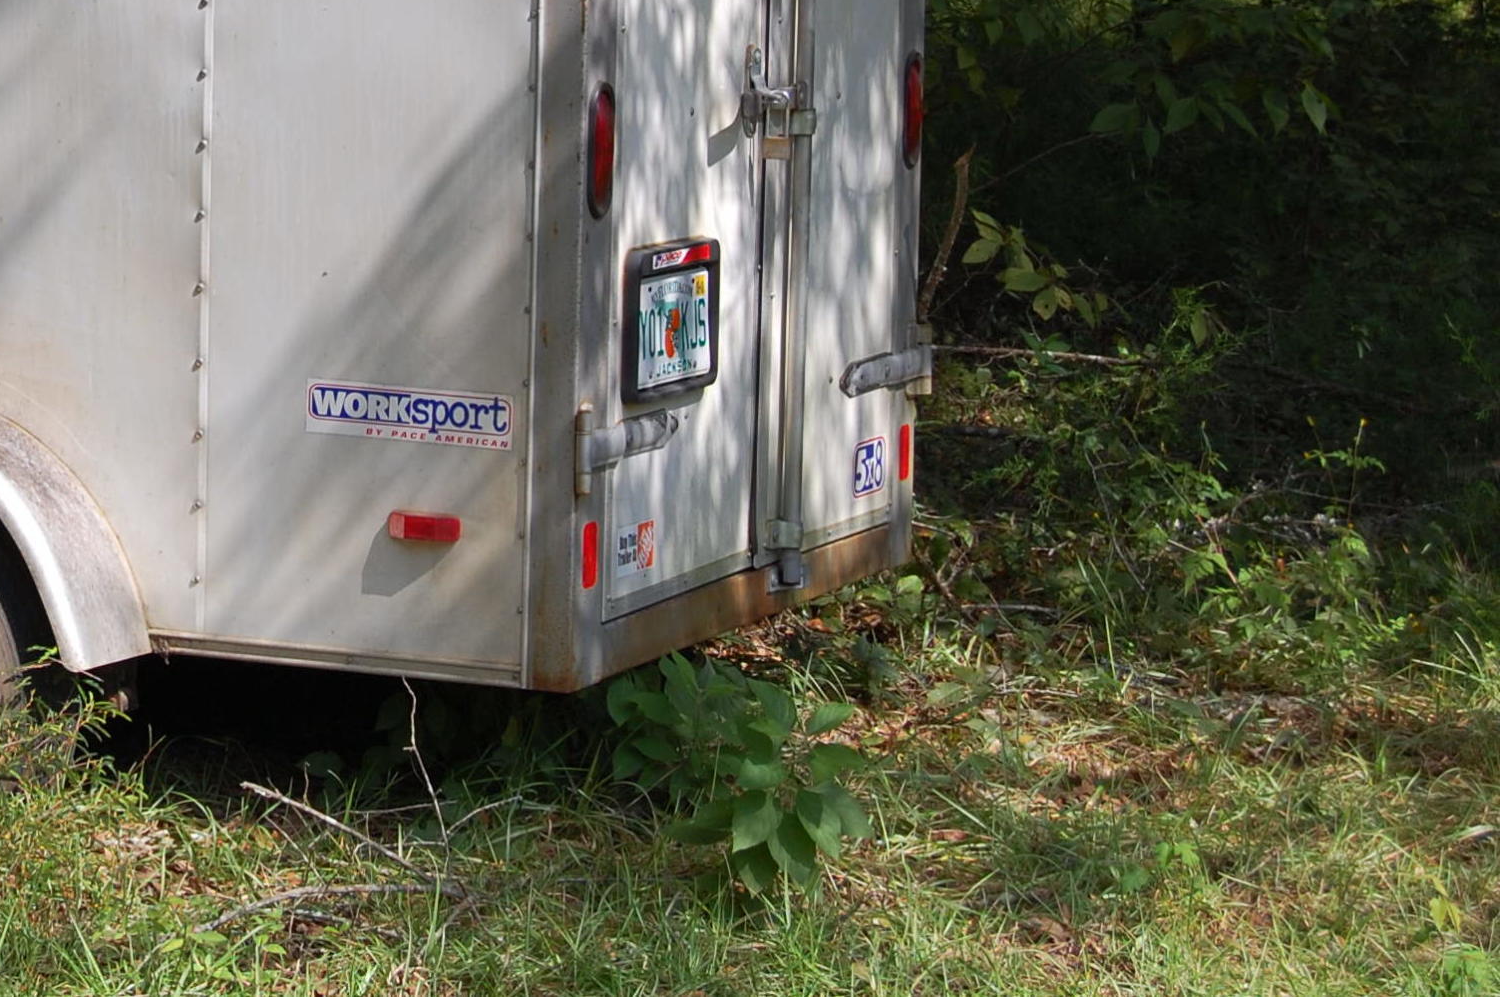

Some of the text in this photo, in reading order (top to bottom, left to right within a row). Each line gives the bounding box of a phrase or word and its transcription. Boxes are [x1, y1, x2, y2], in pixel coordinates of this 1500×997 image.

[656, 359, 693, 377] JACKSON
[312, 387, 508, 433] WORKsport
[366, 427, 509, 448] BY PACE AMERICAN
